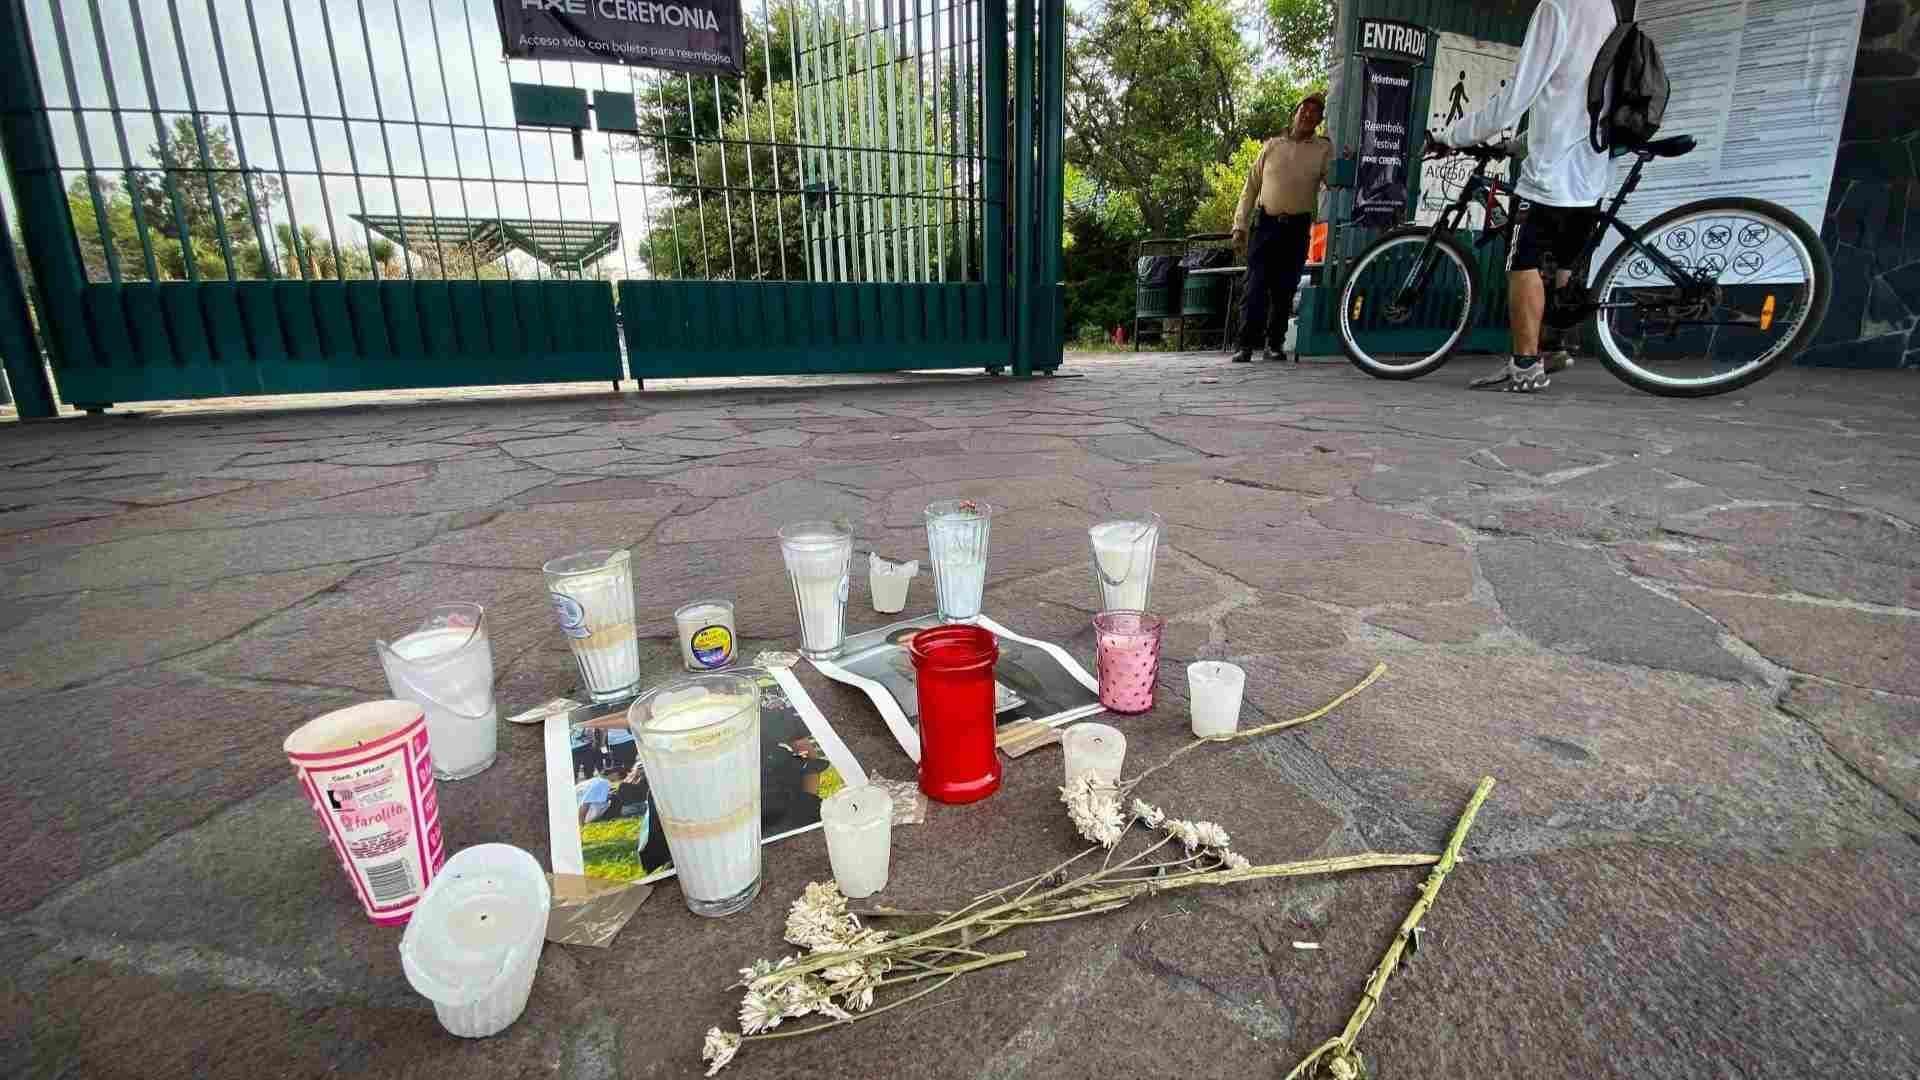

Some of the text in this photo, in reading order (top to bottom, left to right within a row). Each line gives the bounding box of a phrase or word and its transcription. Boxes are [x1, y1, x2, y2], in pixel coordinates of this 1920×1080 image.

[599, 0, 719, 32] CEREMONIA
[520, 34, 560, 48] Acceso
[588, 41, 610, 50] con
[612, 41, 648, 54] boleto
[650, 47, 675, 57] para
[1363, 23, 1426, 58] ENTRADA
